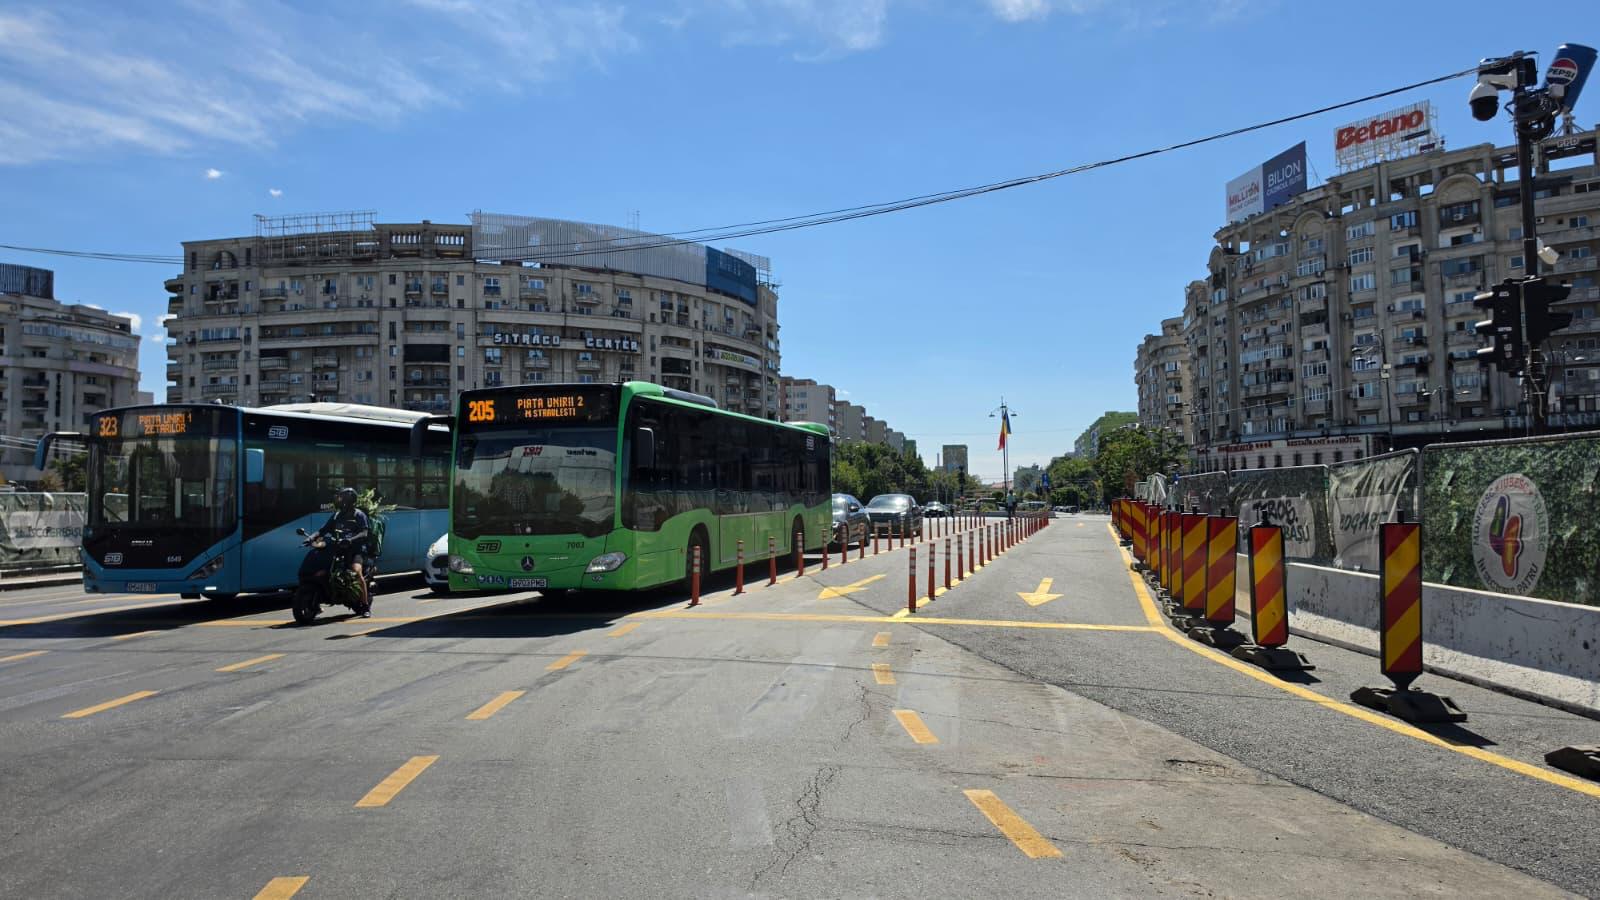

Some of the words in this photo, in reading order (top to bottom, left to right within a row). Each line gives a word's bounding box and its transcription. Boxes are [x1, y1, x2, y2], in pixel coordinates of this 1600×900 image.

[1548, 67, 1576, 79] PEPSI
[1336, 110, 1424, 150] Betano
[1267, 160, 1301, 188] BILION
[1228, 181, 1260, 208] MILLION
[494, 333, 561, 346] SITRACO
[586, 337, 638, 351] CENTER
[468, 400, 495, 421] 205
[517, 398, 544, 409] PIATA
[547, 396, 574, 408] UNIRII
[577, 396, 584, 407] 2
[99, 416, 118, 437] 323
[476, 540, 502, 553] STB
